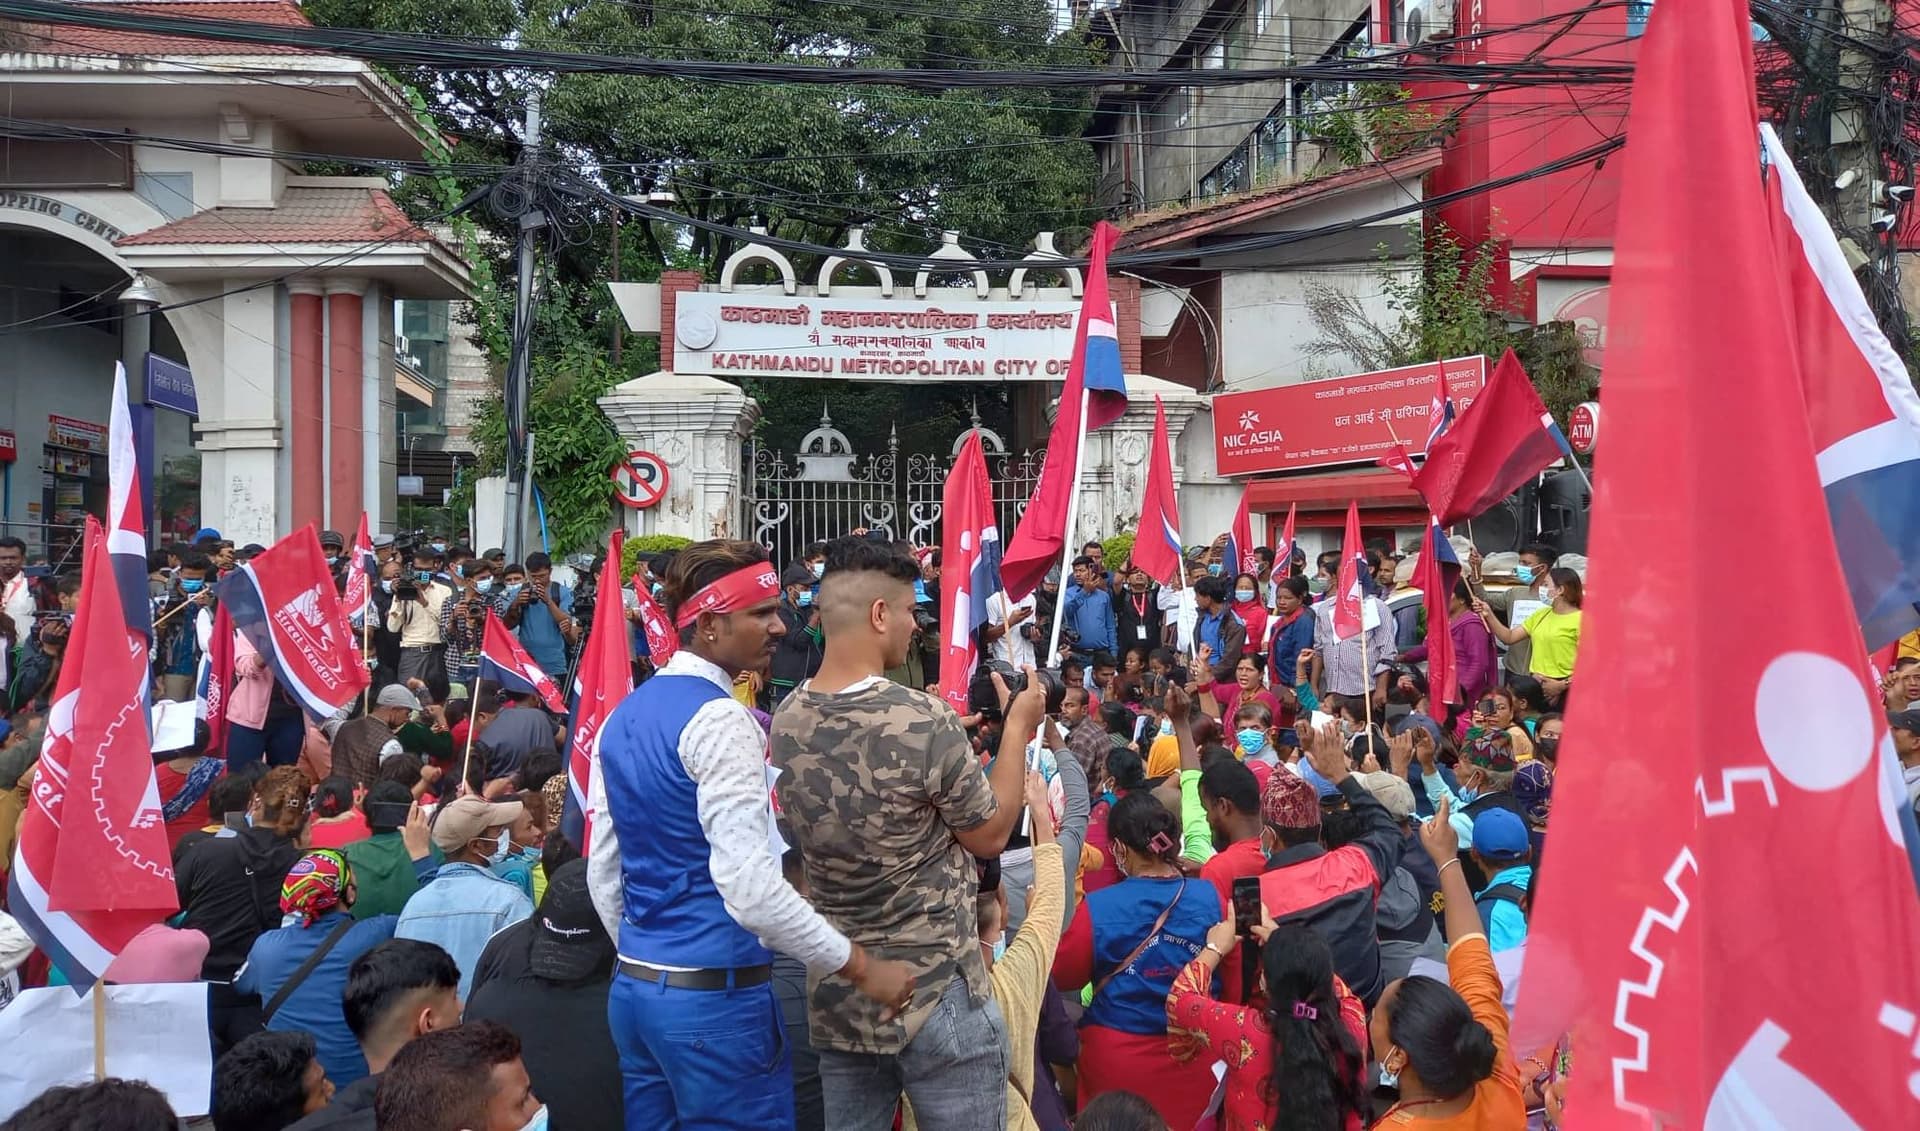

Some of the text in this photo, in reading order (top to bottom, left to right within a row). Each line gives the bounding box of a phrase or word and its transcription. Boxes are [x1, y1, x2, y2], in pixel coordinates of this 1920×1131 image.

[75, 211, 126, 243] CENT
[821, 308, 979, 330] महानगरपालिका
[712, 353, 834, 374] KATHMANDU
[841, 358, 985, 376] METROPOLITAN
[994, 360, 1038, 376] CITY
[1223, 430, 1284, 448] NIC ASIA
[1572, 424, 1592, 439] ATM
